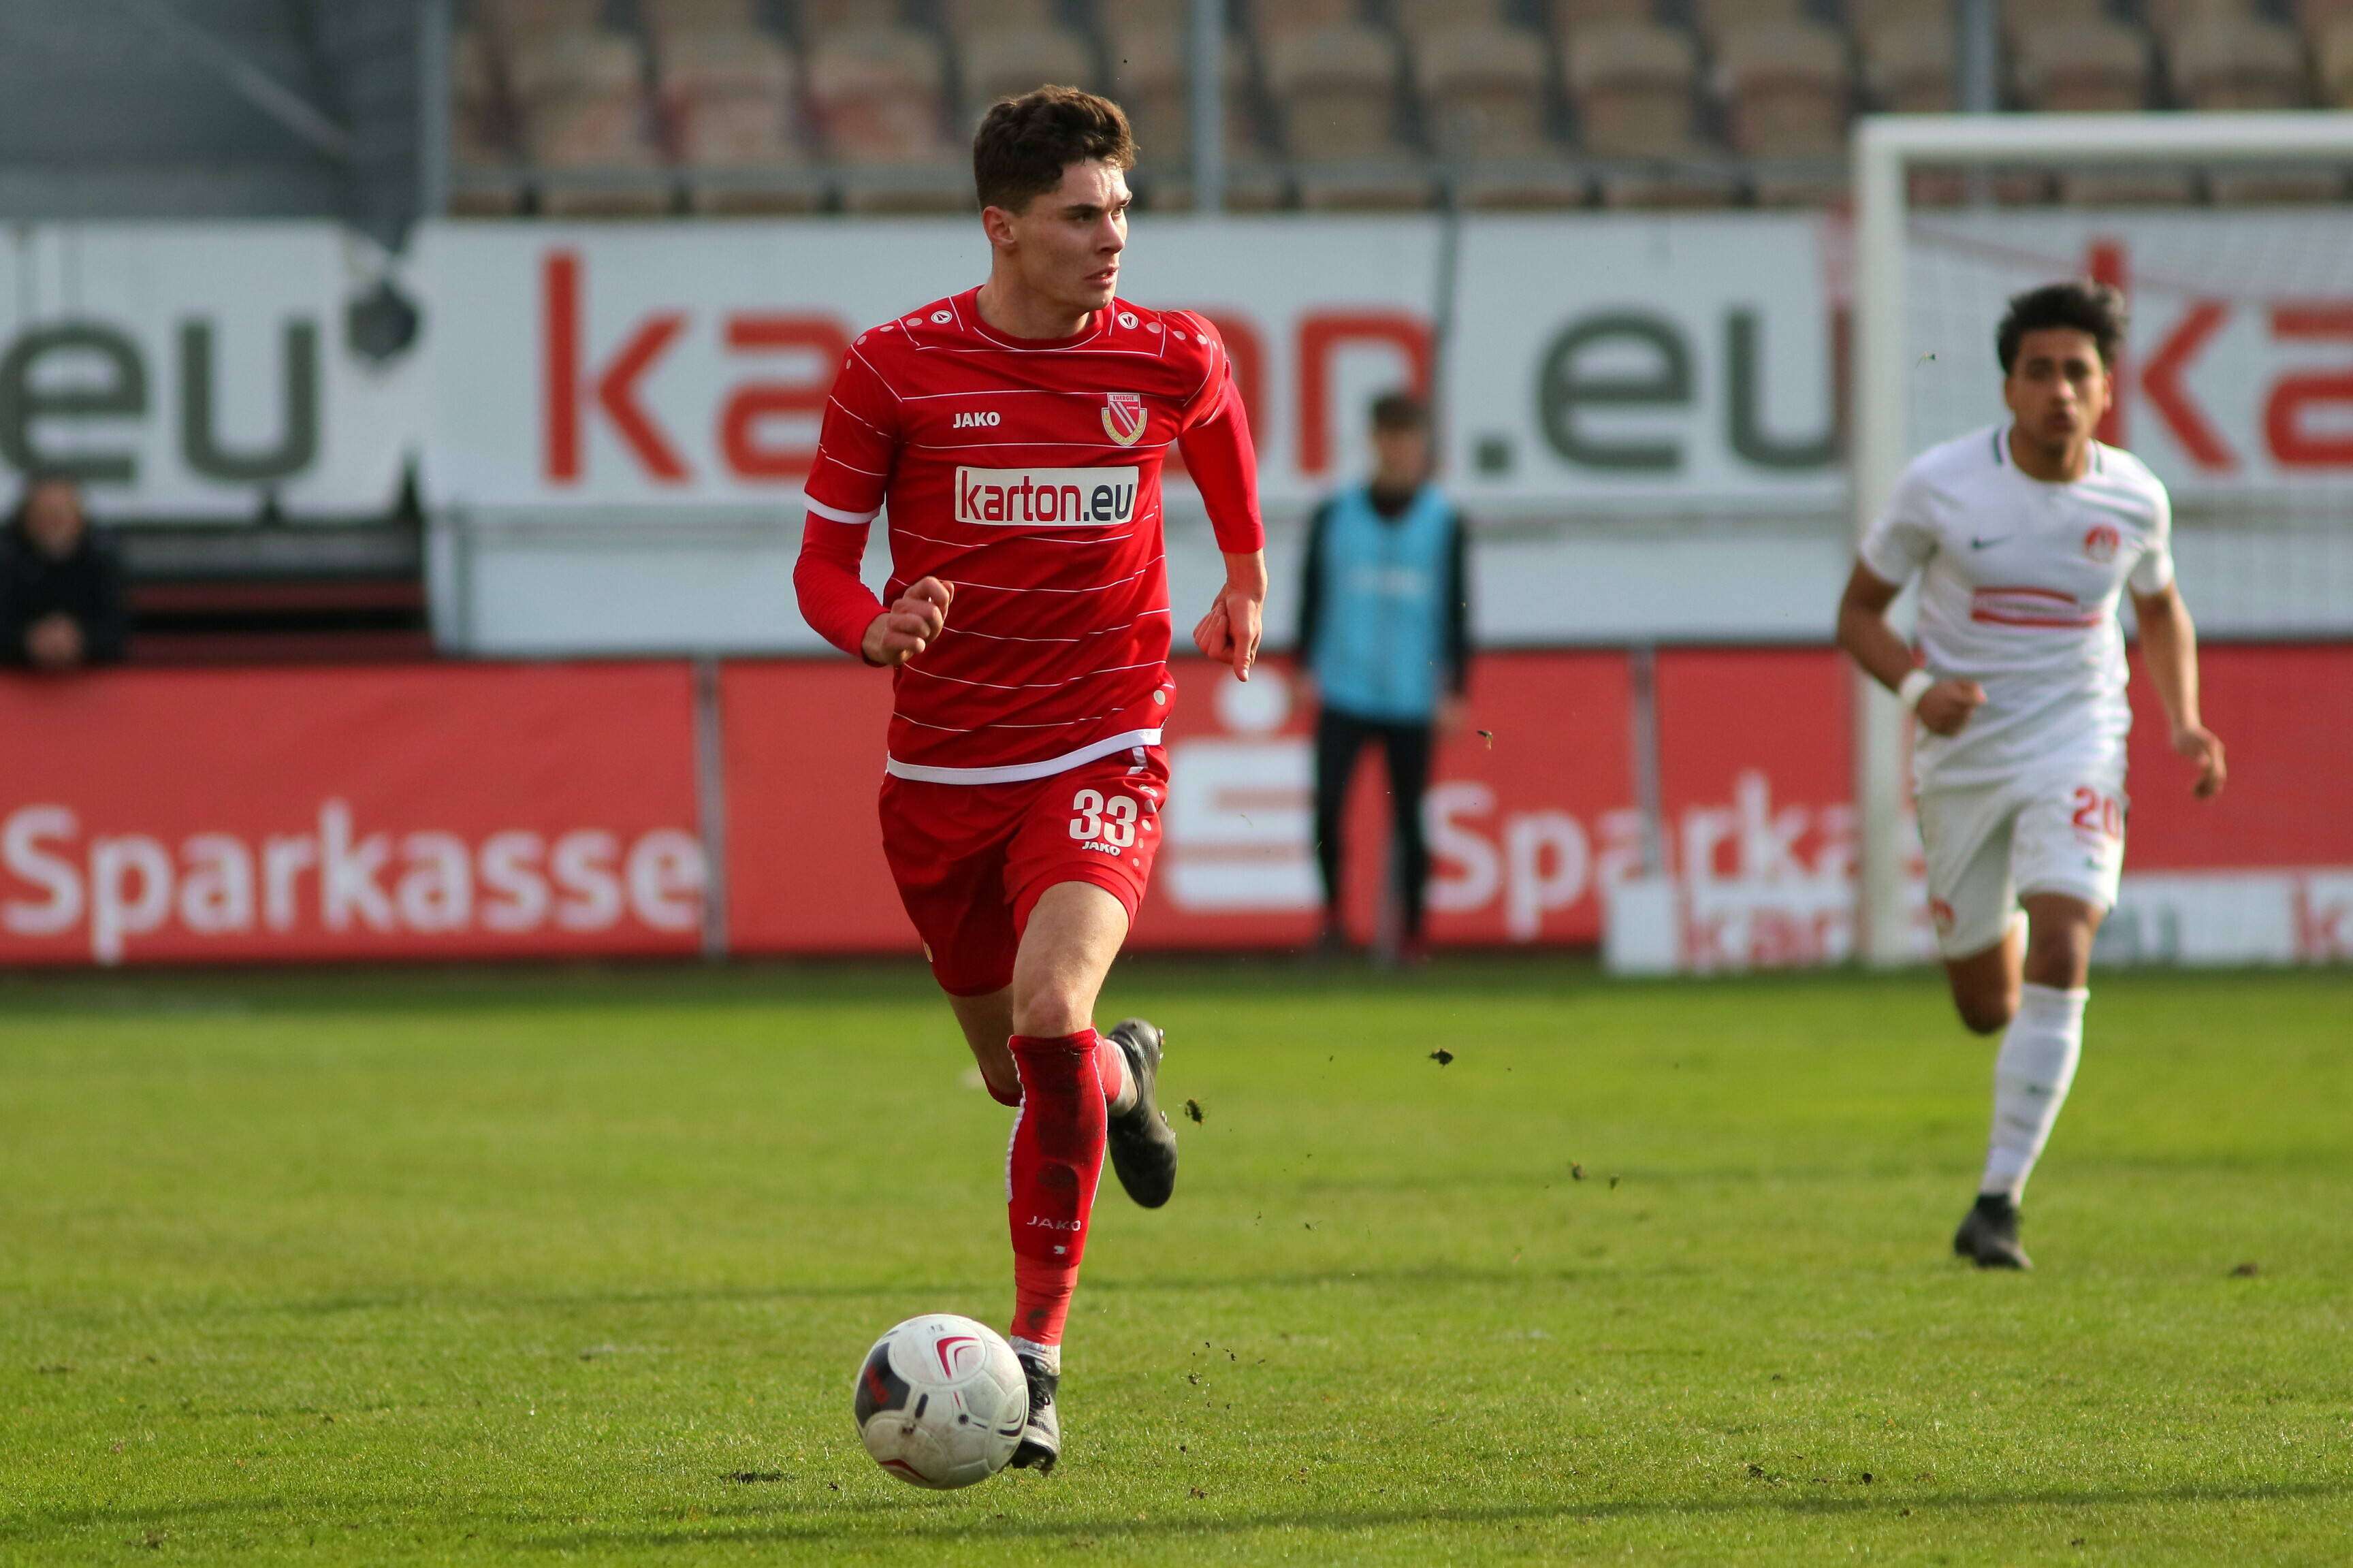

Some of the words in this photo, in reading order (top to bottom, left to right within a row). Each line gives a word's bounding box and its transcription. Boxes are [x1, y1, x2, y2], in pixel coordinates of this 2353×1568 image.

[542, 248, 1851, 482] kan.eu
[953, 411, 1001, 429] JAKO
[961, 470, 1133, 522] karton.eu
[1069, 788, 1138, 848] 33
[2072, 787, 2122, 840] 20
[1082, 841, 1121, 856] JAKO
[1, 797, 708, 964] Sparkasse
[1027, 1215, 1081, 1231] JAKO
